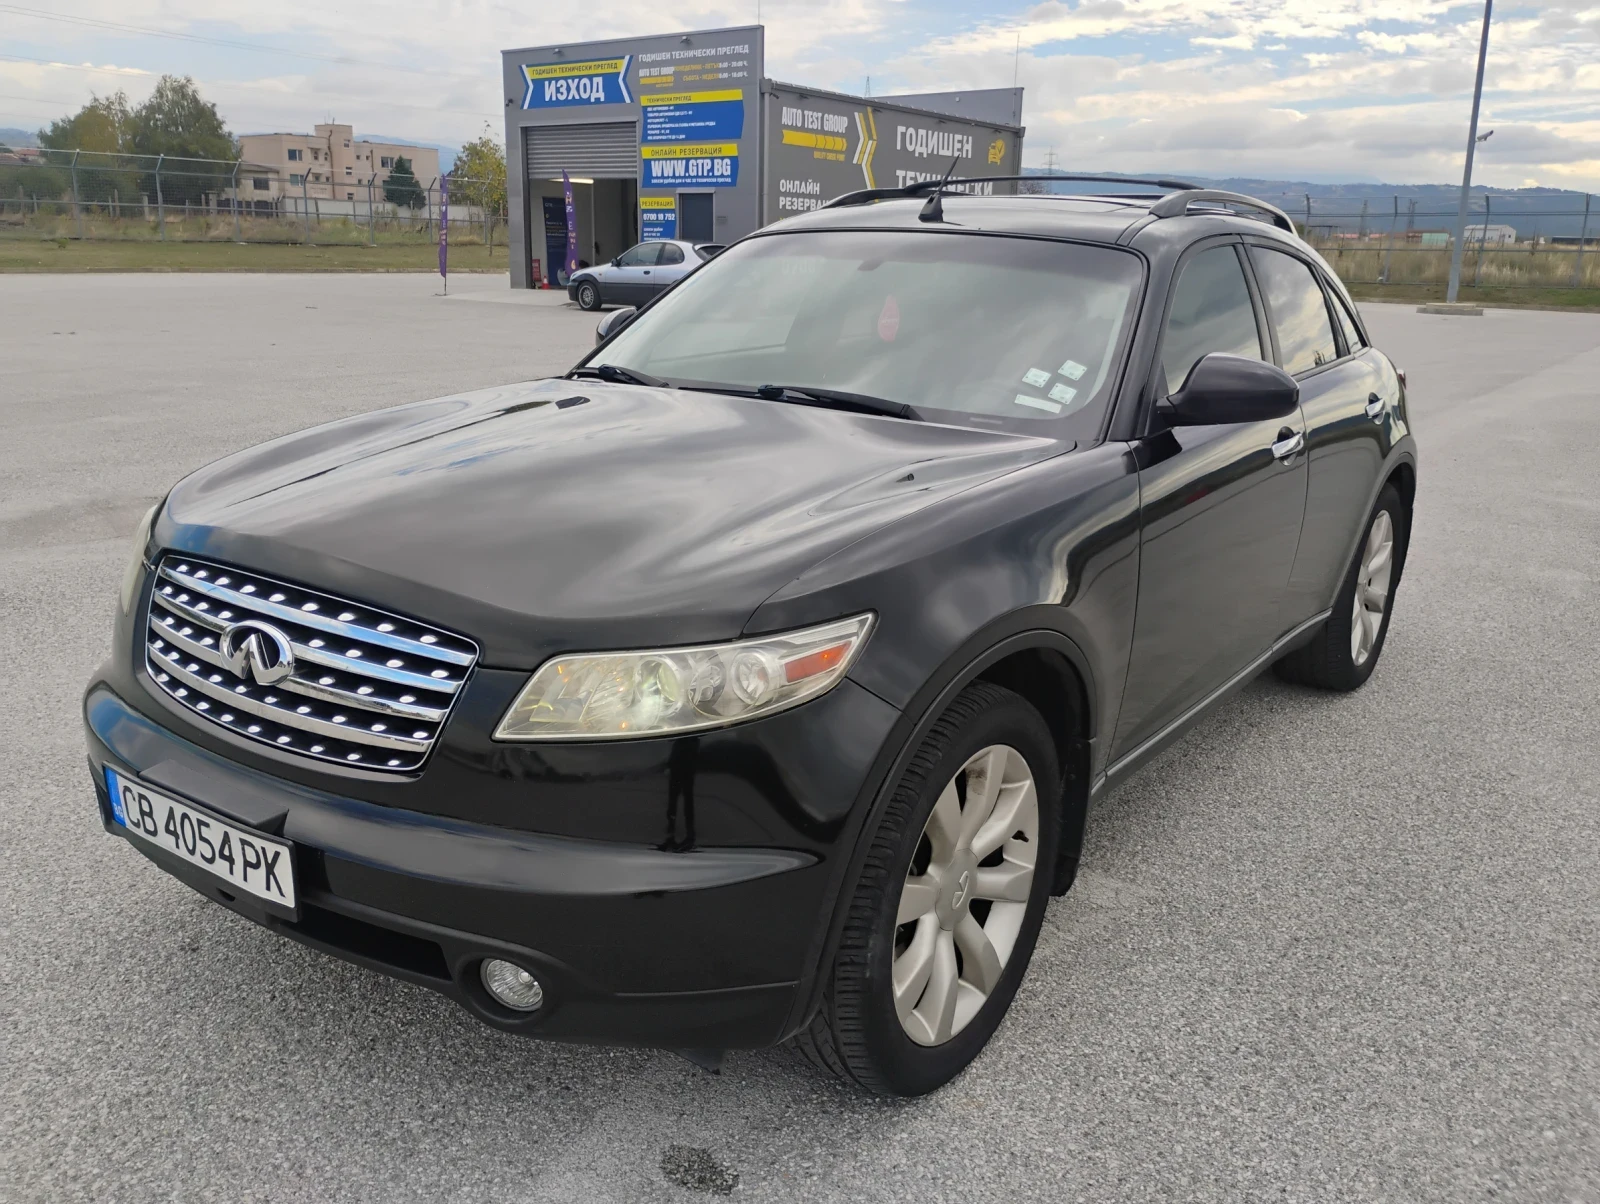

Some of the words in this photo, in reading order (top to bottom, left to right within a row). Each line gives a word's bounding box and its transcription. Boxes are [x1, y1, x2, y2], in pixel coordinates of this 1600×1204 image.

[639, 52, 671, 62] ГОДИШЕН
[672, 48, 716, 60] ТЕХНИЧЕСКИ
[717, 44, 749, 55] ПРЕГЛЕД
[532, 66, 557, 75] ГОДИШЕН
[558, 64, 592, 73] ТЕХНИЧЕСКИ
[593, 62, 618, 70] ПРЕГЛЕД
[544, 76, 605, 102] ИЗХОД
[782, 106, 803, 127] AUTO
[804, 110, 822, 130] TEST
[823, 113, 848, 133] GROUP
[896, 125, 973, 158] ГОДИШЕН
[651, 148, 677, 156] ОНЛАЙН
[679, 147, 722, 155] РЕЗЕРВАЦИЯ
[650, 158, 731, 177] WWW.GTP.BG
[780, 179, 820, 195] ОНЛАЙН
[122, 785, 158, 837] CB
[164, 805, 235, 875] 4054
[239, 837, 286, 898] PK
